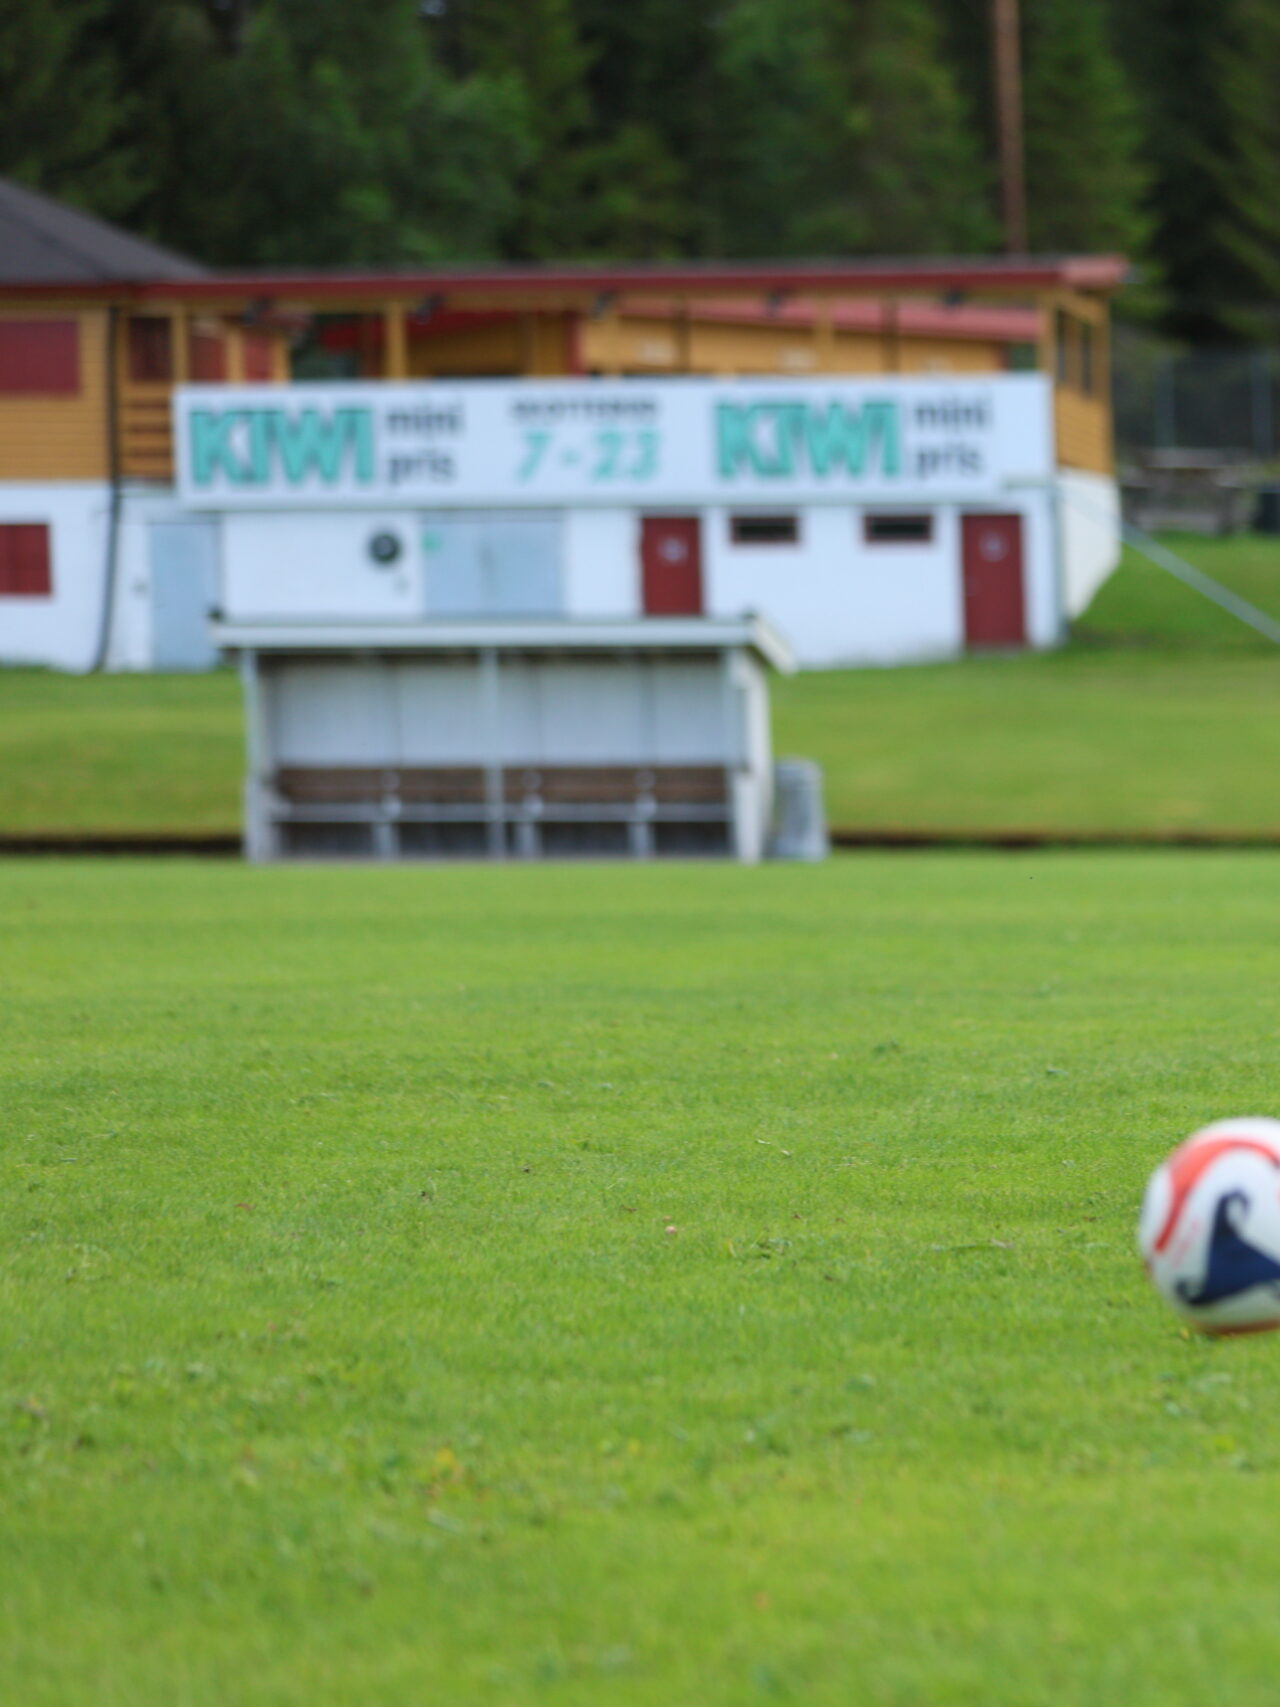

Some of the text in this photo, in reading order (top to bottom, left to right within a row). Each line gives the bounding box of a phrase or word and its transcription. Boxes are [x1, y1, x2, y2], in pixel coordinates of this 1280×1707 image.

[387, 400, 463, 434] mini
[914, 396, 988, 430] mini
[189, 405, 374, 484] KIWI
[716, 399, 898, 479] KIWI
[388, 450, 457, 488] pris
[915, 445, 983, 481] pris
